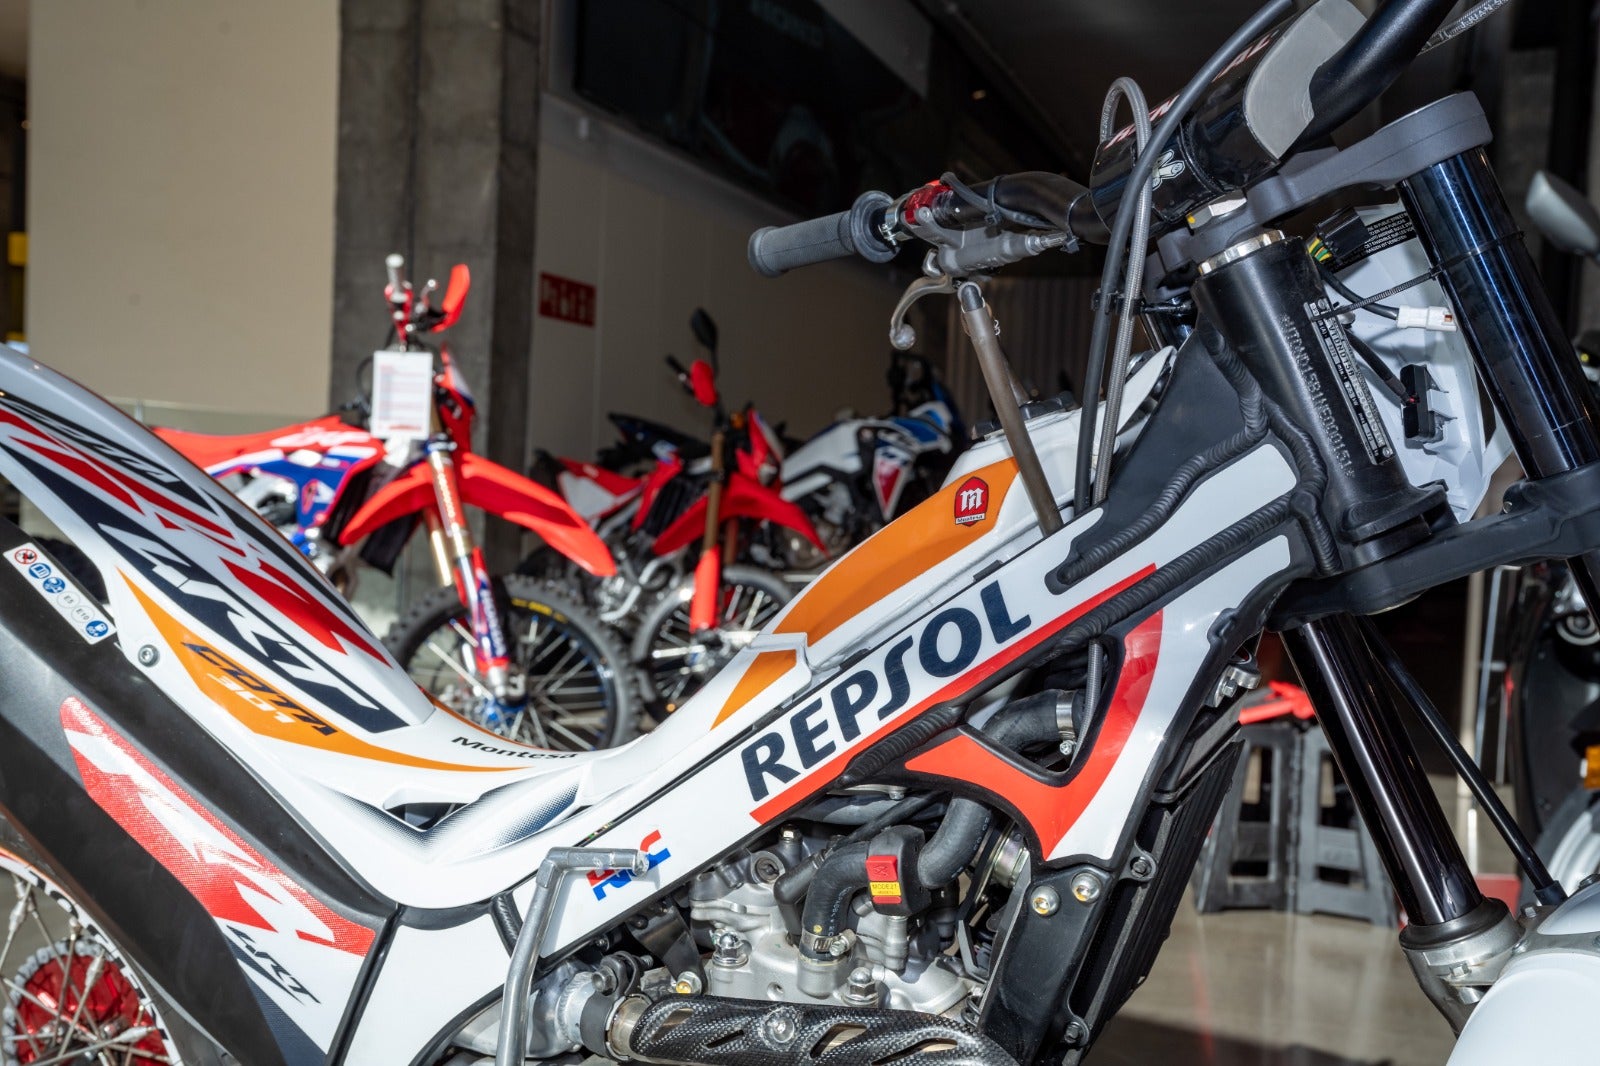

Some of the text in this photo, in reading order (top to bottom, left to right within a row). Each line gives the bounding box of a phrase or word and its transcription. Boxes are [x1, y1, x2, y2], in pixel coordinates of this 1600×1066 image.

[63, 594, 74, 604] E5
[75, 607, 90, 621] E10
[207, 672, 296, 724] 301
[741, 579, 1032, 802] REPSOL
[451, 736, 578, 759] Montesa
[226, 924, 322, 1004] 4RT
